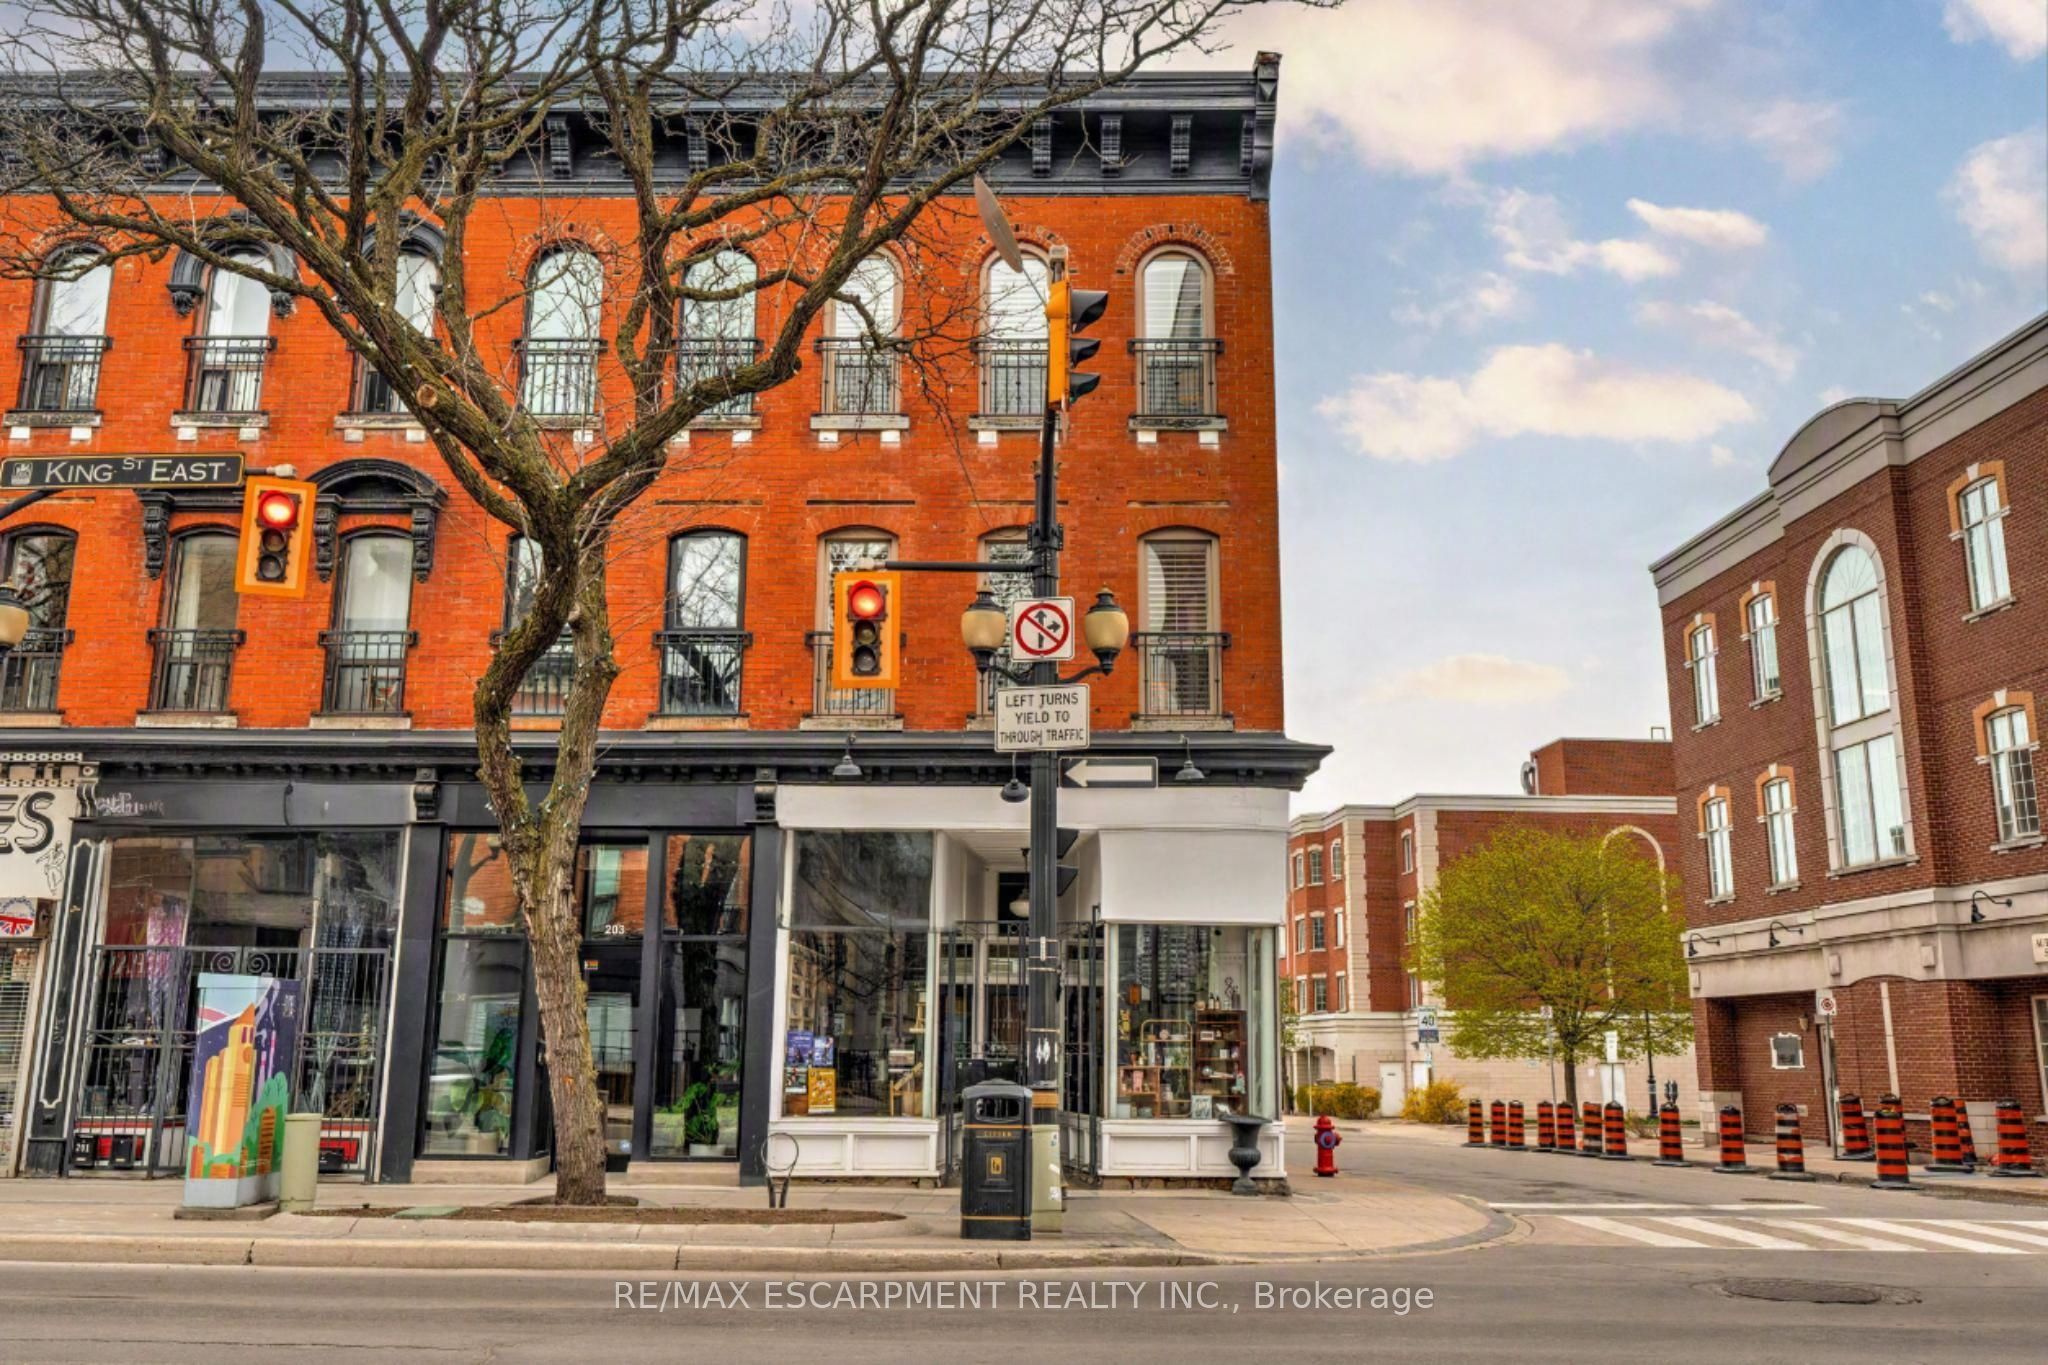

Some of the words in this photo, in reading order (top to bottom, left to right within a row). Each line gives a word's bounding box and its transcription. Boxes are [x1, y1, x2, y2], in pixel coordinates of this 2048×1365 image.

[45, 461, 113, 483] KING
[151, 459, 226, 482] EAST
[1005, 694, 1034, 708] LEFT
[1039, 692, 1079, 708] TURNS
[1015, 711, 1050, 725] YIELD
[1055, 710, 1070, 723] TO
[1000, 730, 1042, 745] THROUGH
[1046, 728, 1084, 741] TRAFFIC
[604, 924, 625, 935] 203
